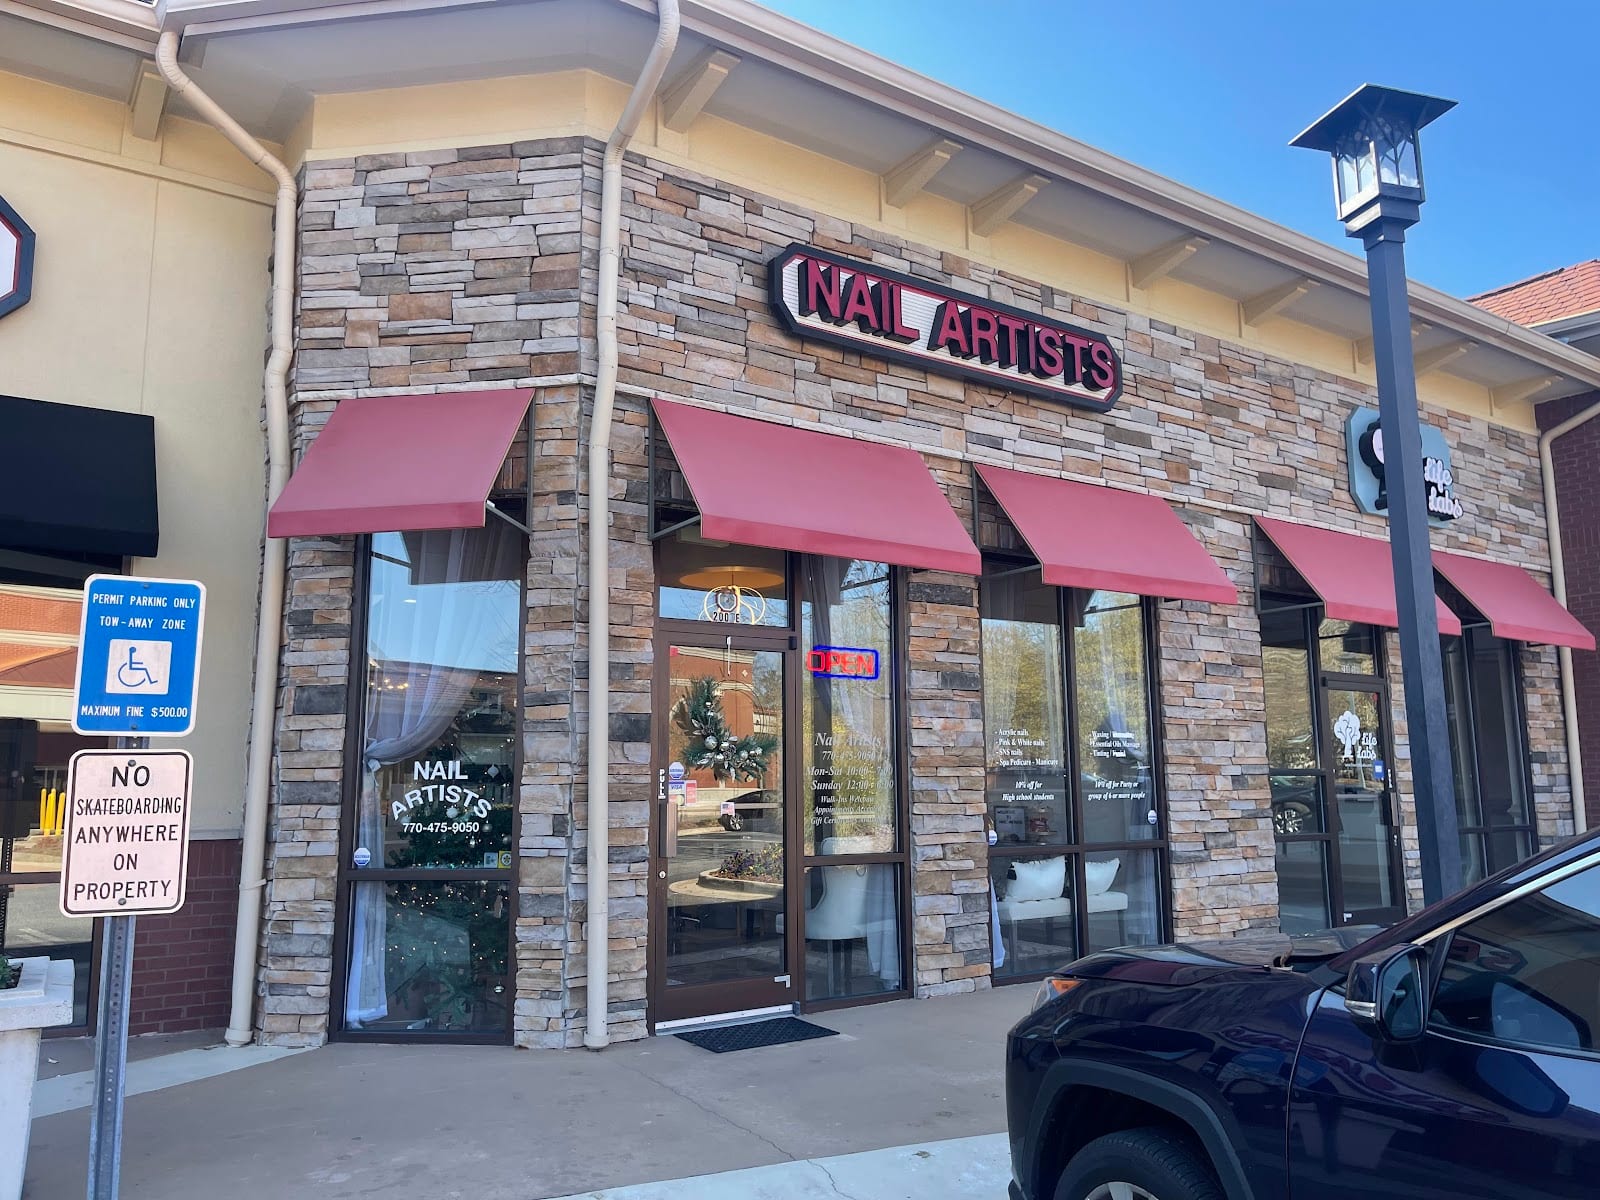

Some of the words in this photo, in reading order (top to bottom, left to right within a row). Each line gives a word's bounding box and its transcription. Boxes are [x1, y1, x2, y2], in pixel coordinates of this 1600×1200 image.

[800, 257, 921, 343] NAIL
[928, 299, 1116, 391] ARTISTS
[92, 593, 124, 605] PERMIT
[130, 594, 168, 608] PARKING
[173, 596, 196, 609] ONLY
[162, 618, 186, 630] ZONE
[713, 611, 729, 623] 200
[735, 613, 740, 623] E
[806, 649, 875, 676] OPEN
[81, 704, 121, 717] MAXIMUM
[126, 706, 144, 718] FINE
[151, 707, 188, 719] $500.00
[998, 738, 1011, 746] Pink
[1017, 738, 1032, 746] White
[413, 760, 469, 781] NAIL
[999, 758, 1010, 768] Spa
[111, 765, 151, 788] NO
[657, 768, 666, 800] PULL
[811, 780, 843, 792] Sunday
[391, 784, 492, 821] ARTISTS
[1002, 793, 1016, 803] High
[1016, 792, 1033, 801] school
[75, 796, 182, 817] SKATEBOARDING
[402, 821, 480, 833] 770-475-9050
[811, 816, 823, 826] Gift
[75, 823, 179, 844] ANYWHERE
[113, 853, 138, 872] ON
[73, 879, 172, 901] PROPERTY
